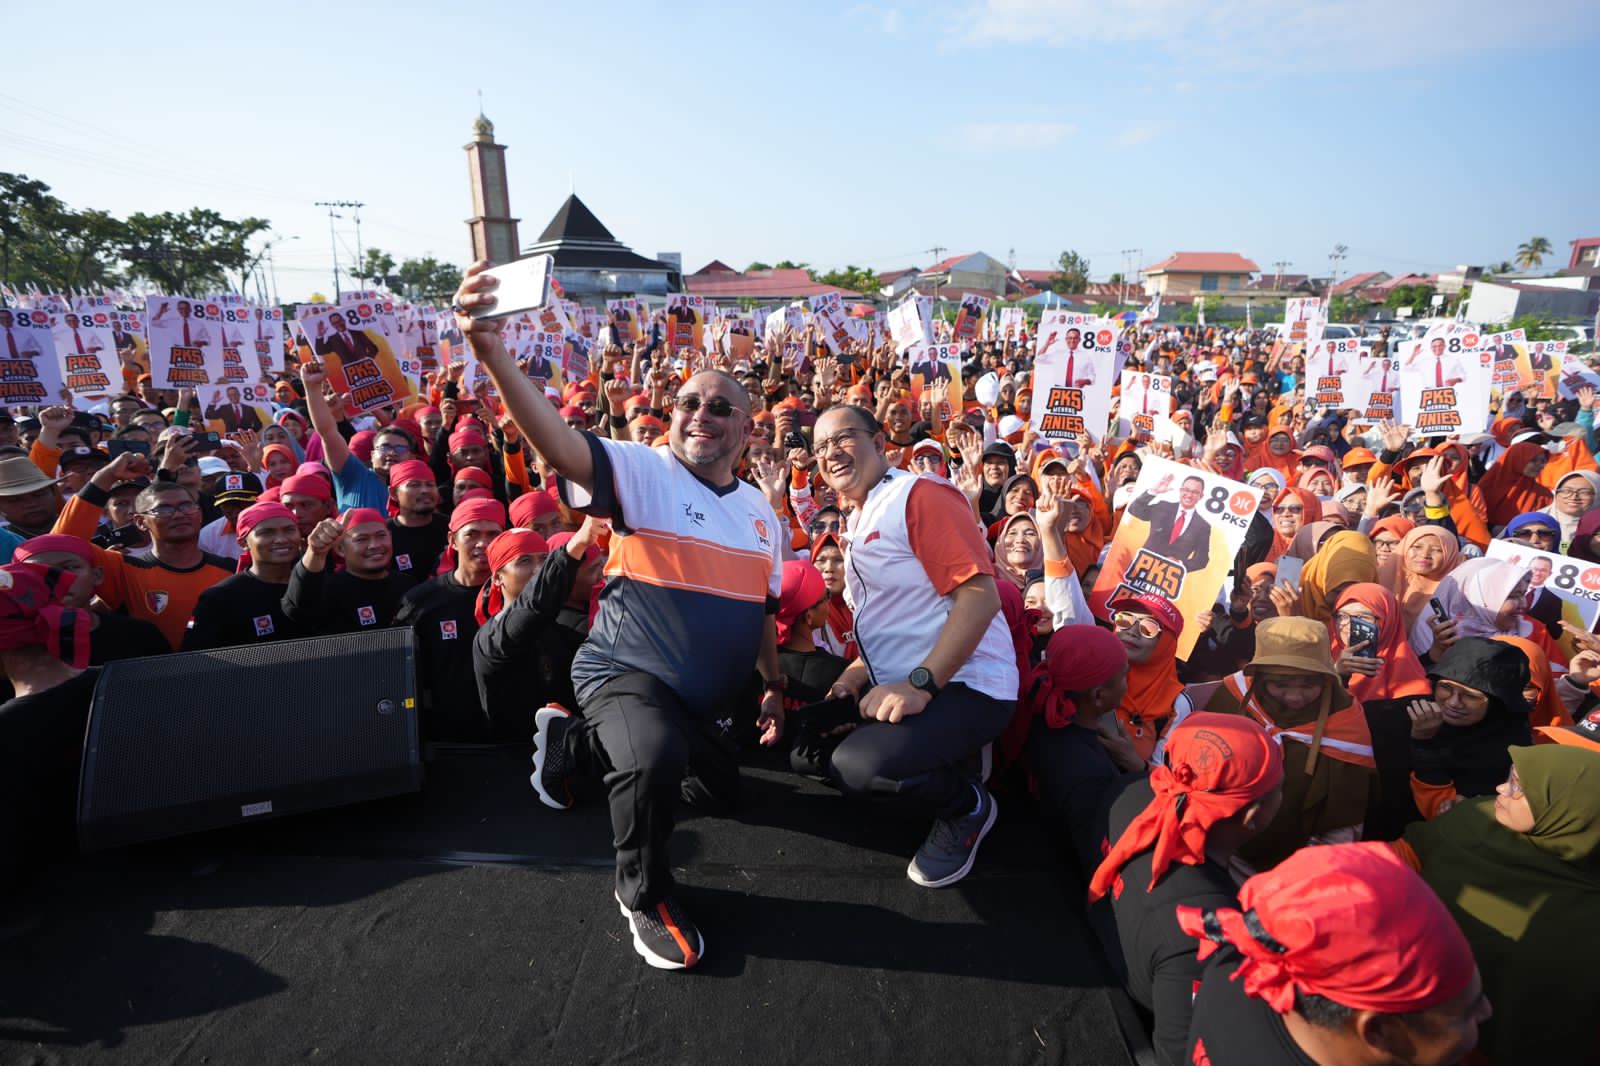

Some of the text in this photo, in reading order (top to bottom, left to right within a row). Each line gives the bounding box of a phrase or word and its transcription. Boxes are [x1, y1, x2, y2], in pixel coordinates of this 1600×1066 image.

[96, 298, 103, 306] 8
[689, 297, 695, 306] 8
[194, 304, 204, 318] 8
[265, 310, 272, 320] 8
[375, 304, 383, 314] 8
[17, 313, 30, 328] 8
[82, 315, 94, 328] 8
[227, 310, 236, 322] 8
[346, 309, 360, 326] 8
[124, 322, 131, 333] 8
[427, 321, 433, 332] 8
[546, 334, 552, 343] 8
[1082, 331, 1095, 350] 8
[1505, 333, 1512, 341] 8
[545, 346, 552, 357] 8
[1338, 343, 1345, 352] 8
[1449, 337, 1460, 353] 8
[1546, 343, 1554, 352] 8
[172, 350, 203, 365] PKS
[940, 349, 948, 361] 8
[68, 356, 101, 371] PKS
[402, 361, 409, 372] 8
[1392, 361, 1399, 371] 8
[347, 361, 379, 384] PKS
[69, 373, 109, 387] ANIES
[1152, 379, 1159, 390] 8
[1319, 377, 1341, 390] PKS
[244, 388, 254, 401] 8
[354, 383, 392, 405] ANIES
[1048, 390, 1082, 411] PKS
[1420, 389, 1456, 408] PKS
[1042, 415, 1084, 433] ANIES
[1416, 412, 1461, 428] ANIES
[1205, 486, 1229, 513] 8
[1222, 512, 1248, 529] PKS
[759, 536, 771, 547] PKS
[1131, 553, 1181, 598] PKS
[1554, 564, 1579, 589] 8
[1572, 588, 1600, 602] PKS
[257, 626, 274, 635] PKS
